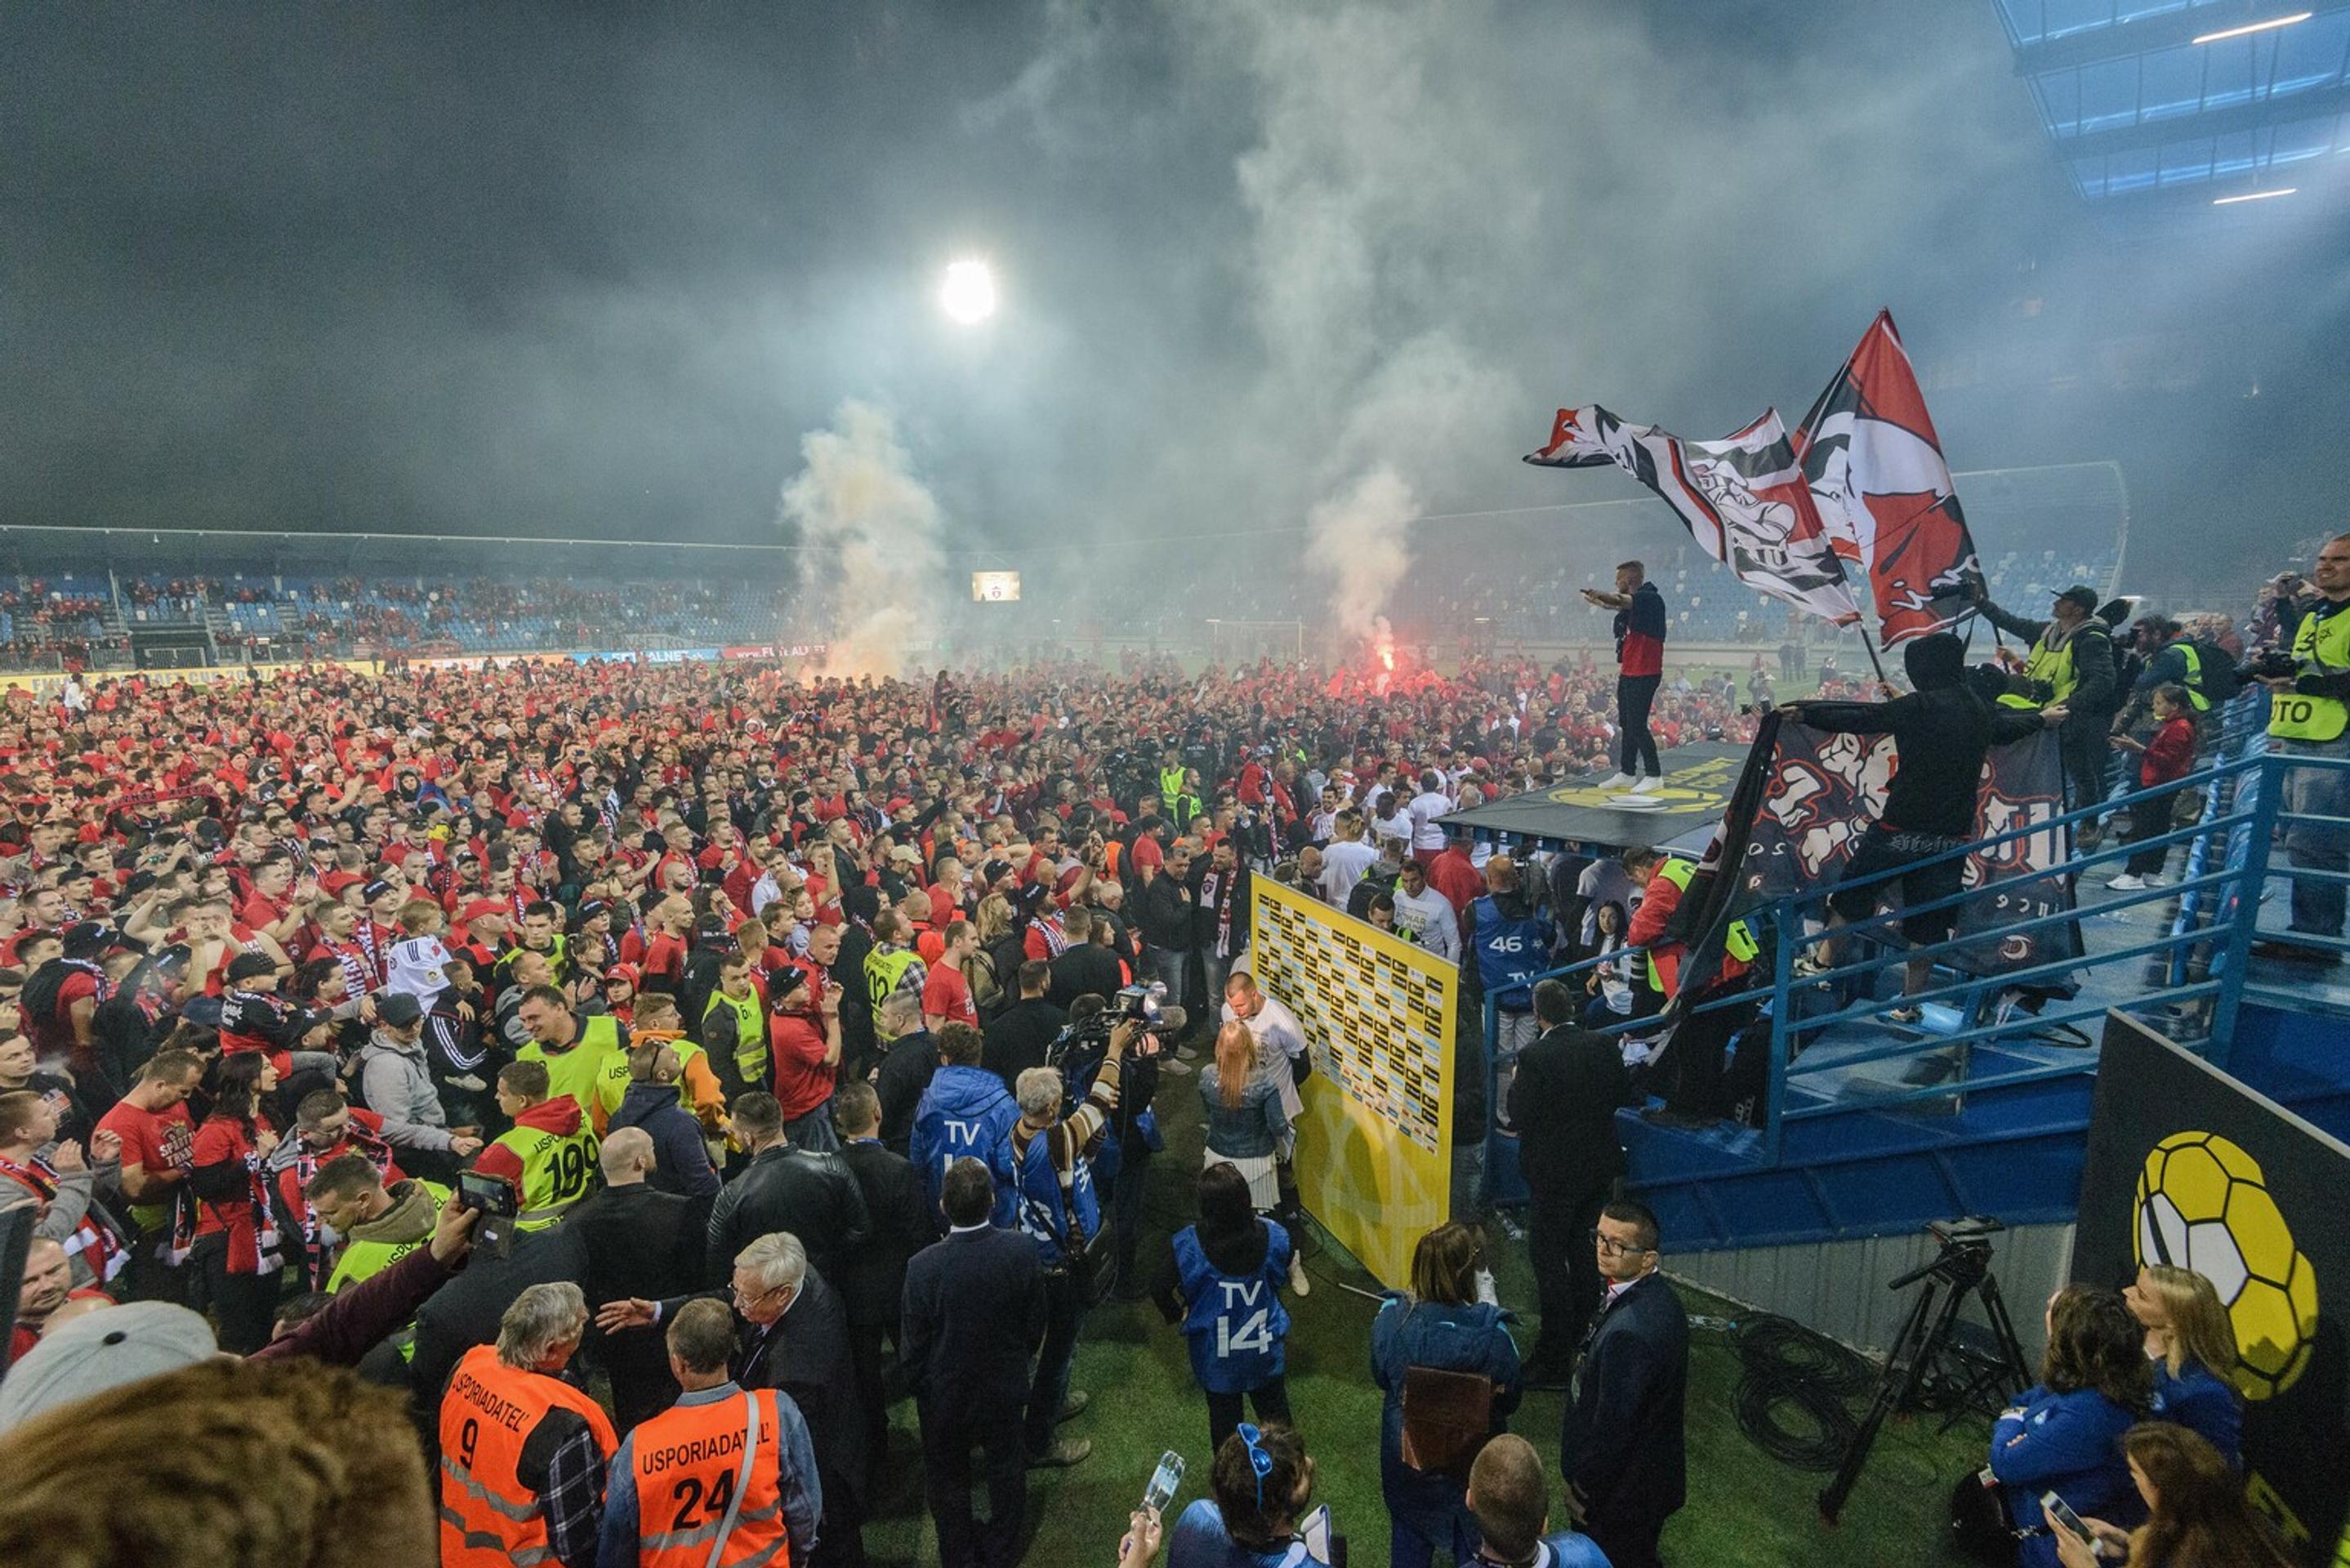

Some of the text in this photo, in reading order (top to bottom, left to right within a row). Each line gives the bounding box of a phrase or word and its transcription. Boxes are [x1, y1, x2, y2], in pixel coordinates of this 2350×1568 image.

[1488, 936, 1523, 953] 46
[943, 1120, 981, 1146] TV
[1218, 1280, 1264, 1309] TV
[1217, 1307, 1273, 1358] 14
[459, 1418, 479, 1470] 9
[671, 1468, 734, 1531] 24
